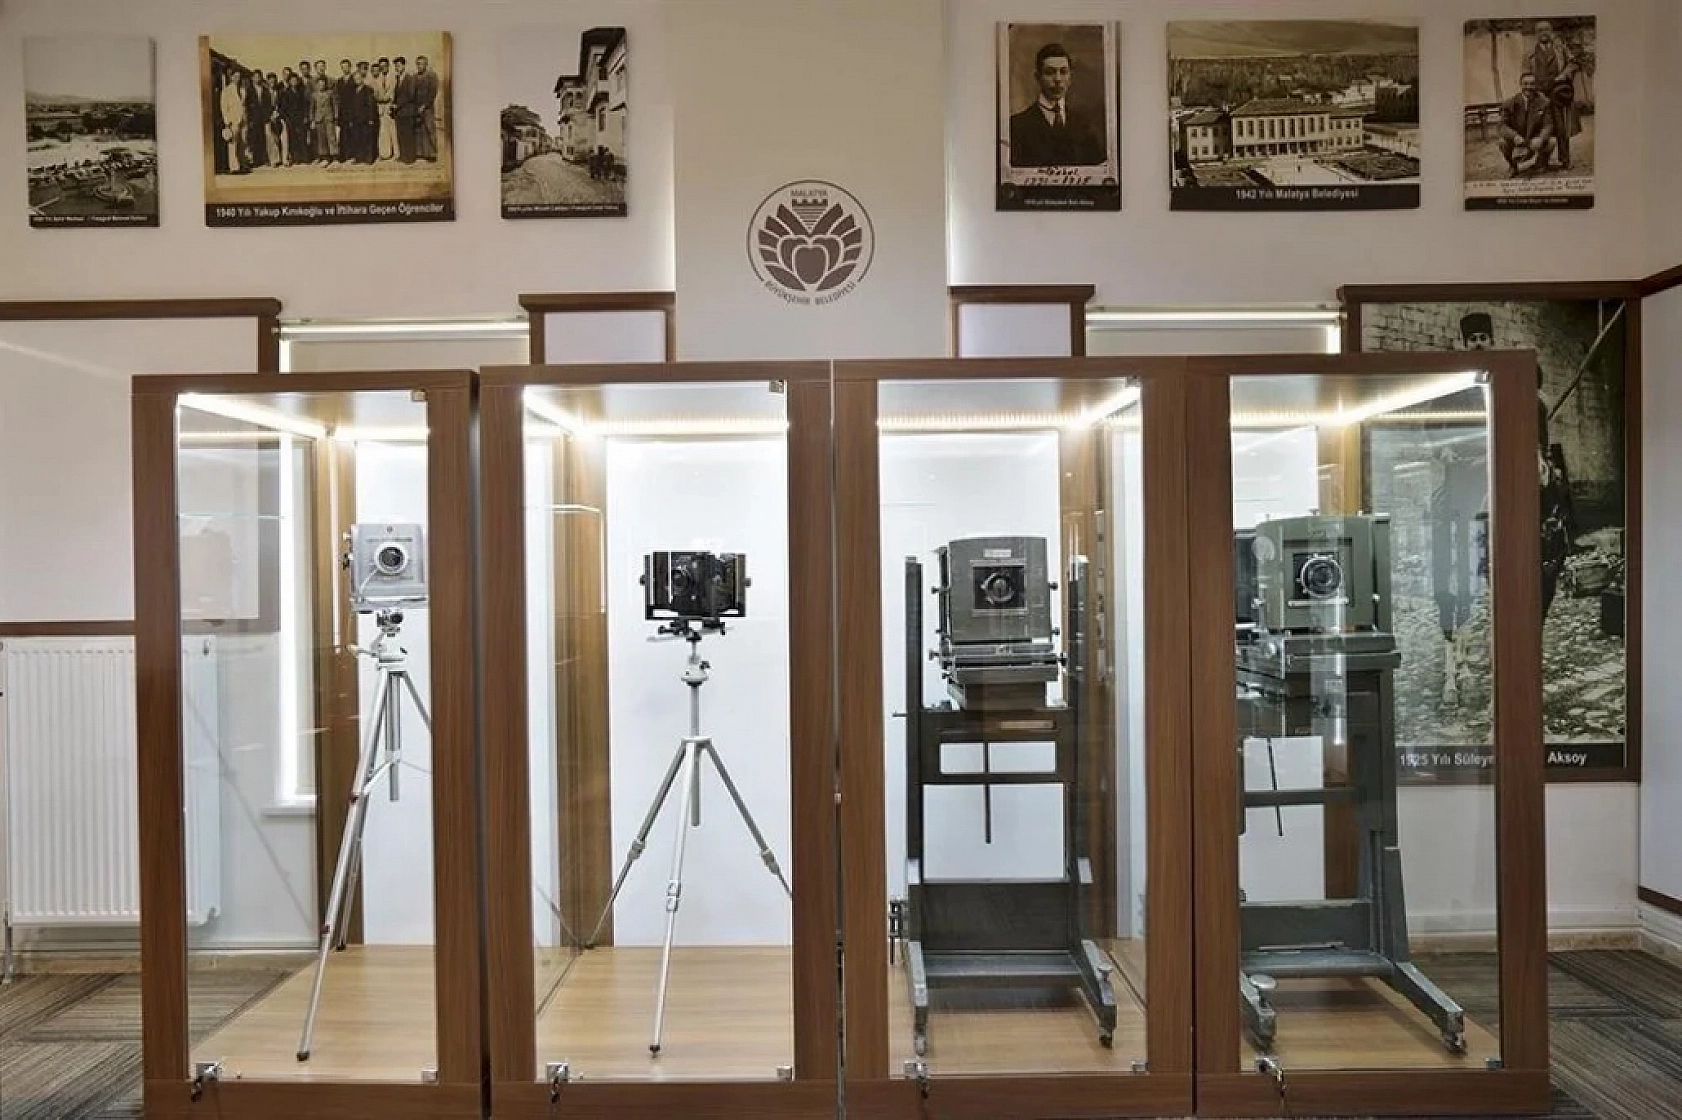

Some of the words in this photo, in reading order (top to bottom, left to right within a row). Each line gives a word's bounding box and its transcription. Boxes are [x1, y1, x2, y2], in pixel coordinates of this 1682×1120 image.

[790, 189, 828, 197] MALATYA
[1235, 189, 1257, 199] 1942
[1275, 189, 1309, 201] Malatya
[1310, 187, 1359, 201] Belediyesi
[1548, 751, 1587, 766] Aksoy
